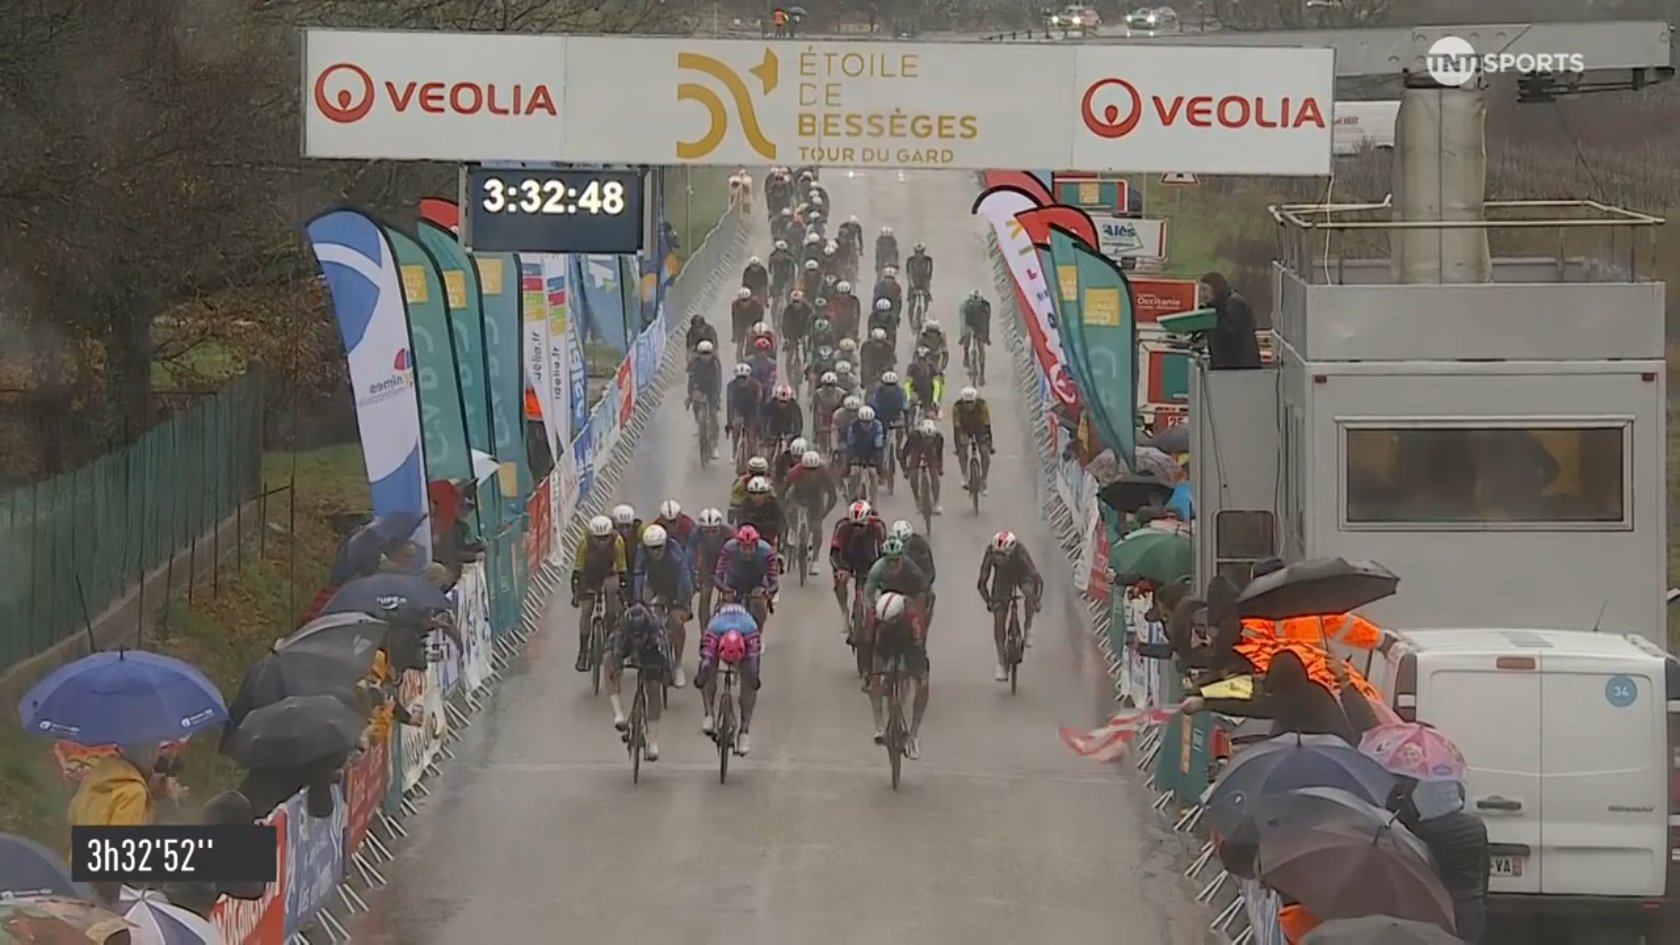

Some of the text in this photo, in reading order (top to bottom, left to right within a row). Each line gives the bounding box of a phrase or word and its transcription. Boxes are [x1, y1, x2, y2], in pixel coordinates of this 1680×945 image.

[799, 46, 919, 78] ÉTOILE
[385, 81, 558, 116] VEOLIA
[799, 83, 842, 106] DE
[797, 108, 978, 138] BESSÈGES
[1152, 96, 1325, 129] VEOLIA
[798, 147, 954, 164] TOUR DU GARD
[482, 179, 625, 215] 3:32:48
[1613, 686, 1629, 696] 34
